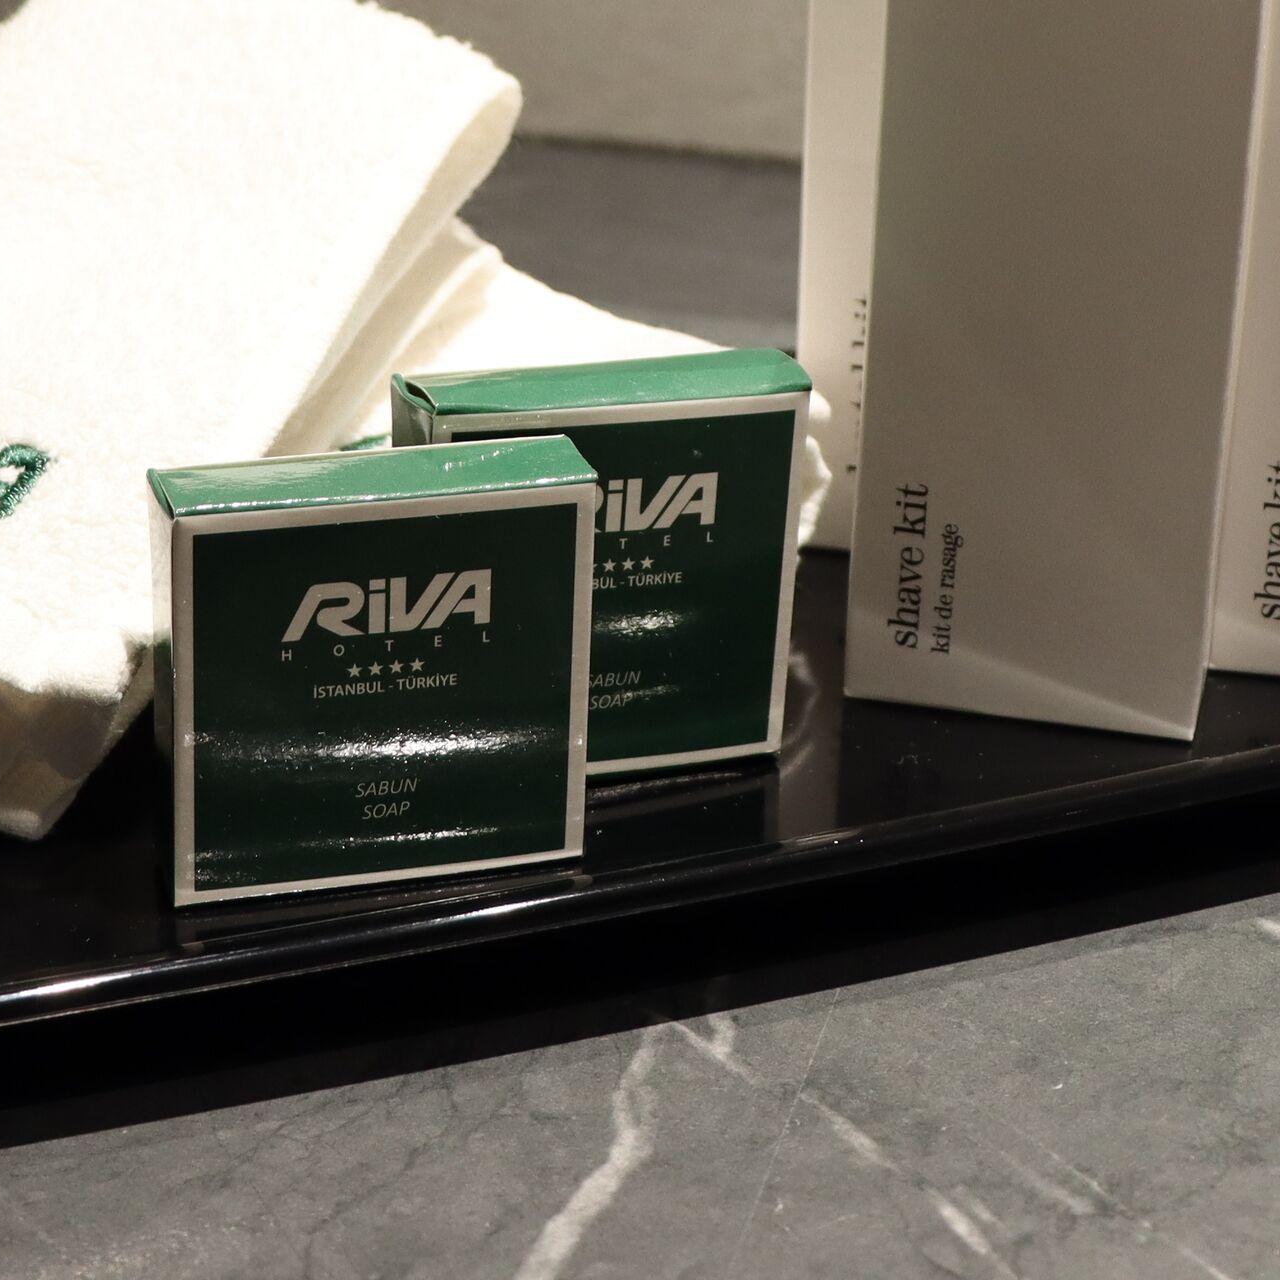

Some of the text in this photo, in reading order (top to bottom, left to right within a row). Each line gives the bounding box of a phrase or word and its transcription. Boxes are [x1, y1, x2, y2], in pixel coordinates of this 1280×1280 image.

[887, 483, 929, 649] shave kit
[628, 572, 682, 587] TÜRKİYE
[930, 523, 963, 654] kit de rasage
[282, 631, 490, 662] HOTEL
[313, 681, 384, 699] İSTANBUL
[396, 673, 458, 690] TÜRKİYE
[589, 695, 633, 710] SOAP
[355, 778, 417, 798] SABUN
[362, 800, 410, 820] SOAP
